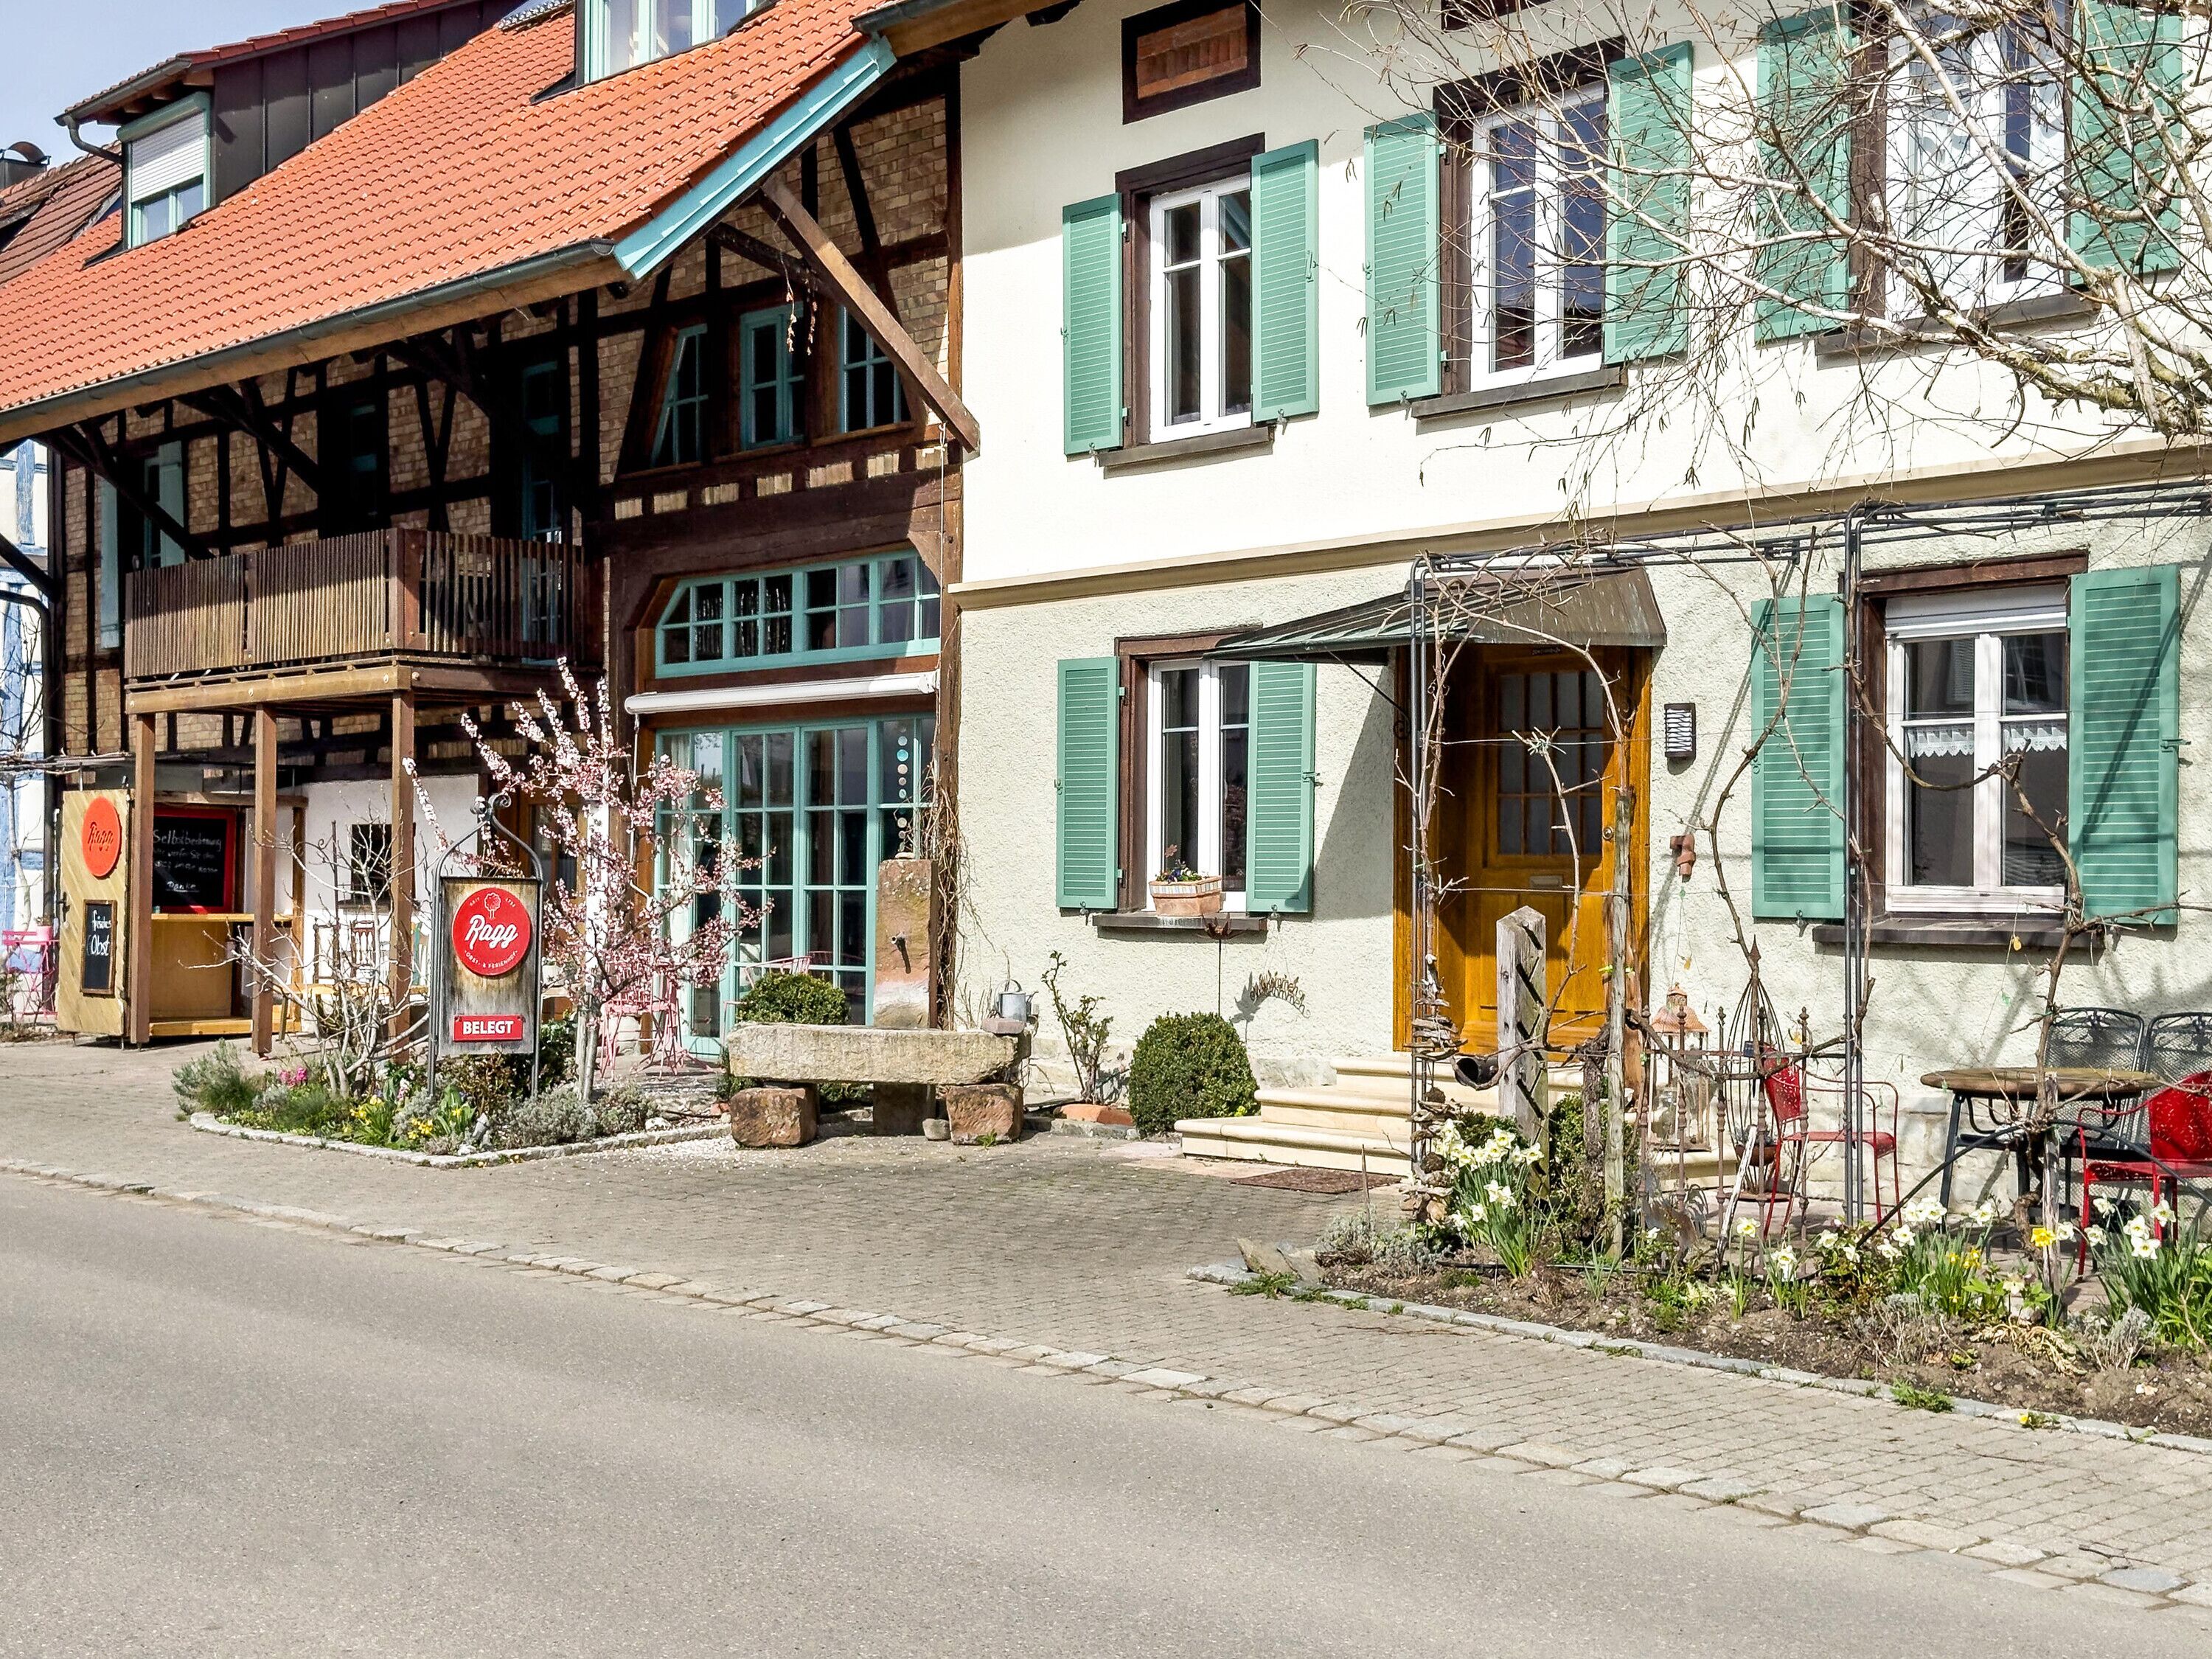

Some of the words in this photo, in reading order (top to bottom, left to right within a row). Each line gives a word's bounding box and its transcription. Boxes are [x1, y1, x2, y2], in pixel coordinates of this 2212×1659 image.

[87, 821, 114, 852] Ragg
[166, 880, 197, 890] Danke
[465, 914, 518, 950] Ragg
[91, 933, 111, 956] Obst
[462, 1020, 514, 1035] BELEGT
